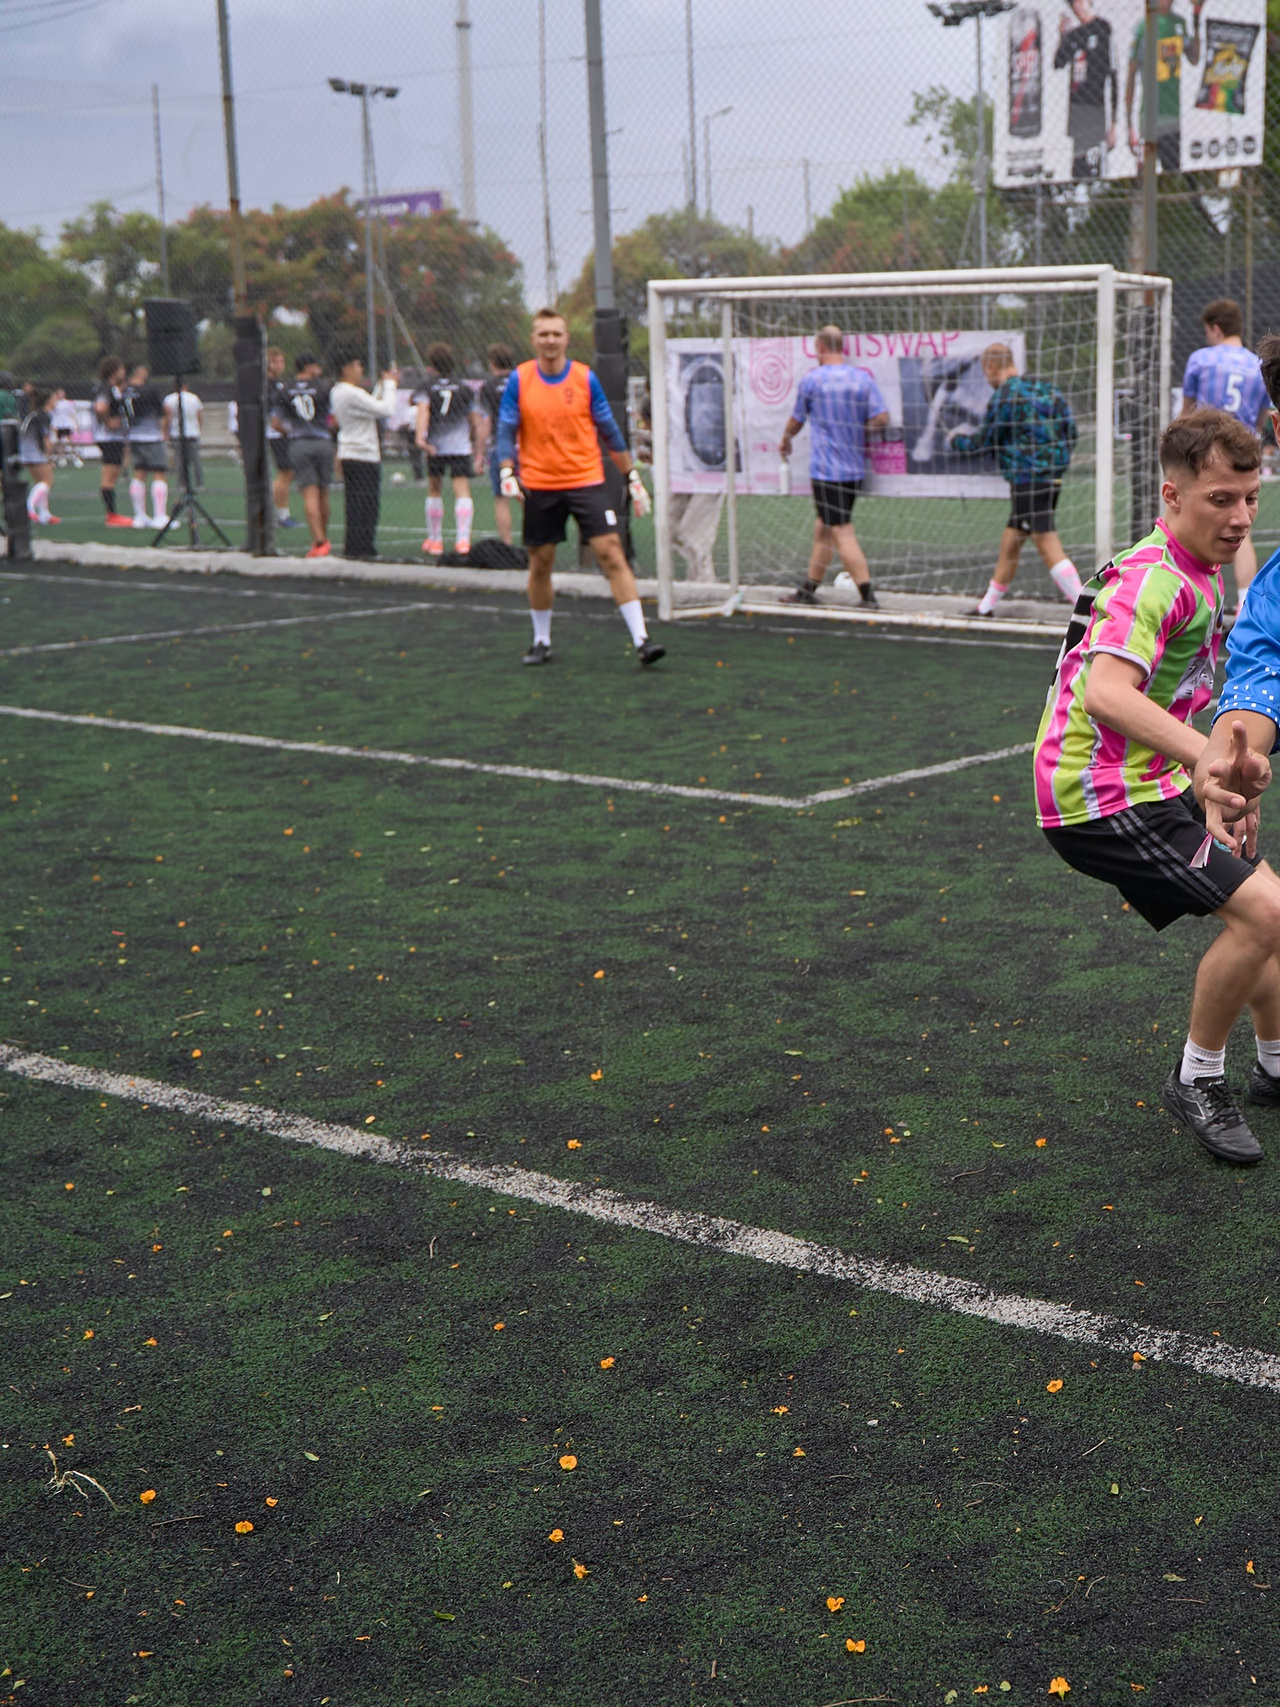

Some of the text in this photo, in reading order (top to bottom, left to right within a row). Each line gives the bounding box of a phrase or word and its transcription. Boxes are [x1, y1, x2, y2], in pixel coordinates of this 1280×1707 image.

[802, 333, 960, 358] UISWAP
[439, 390, 452, 415] 7
[1223, 374, 1245, 412] 5
[292, 394, 316, 421] 10
